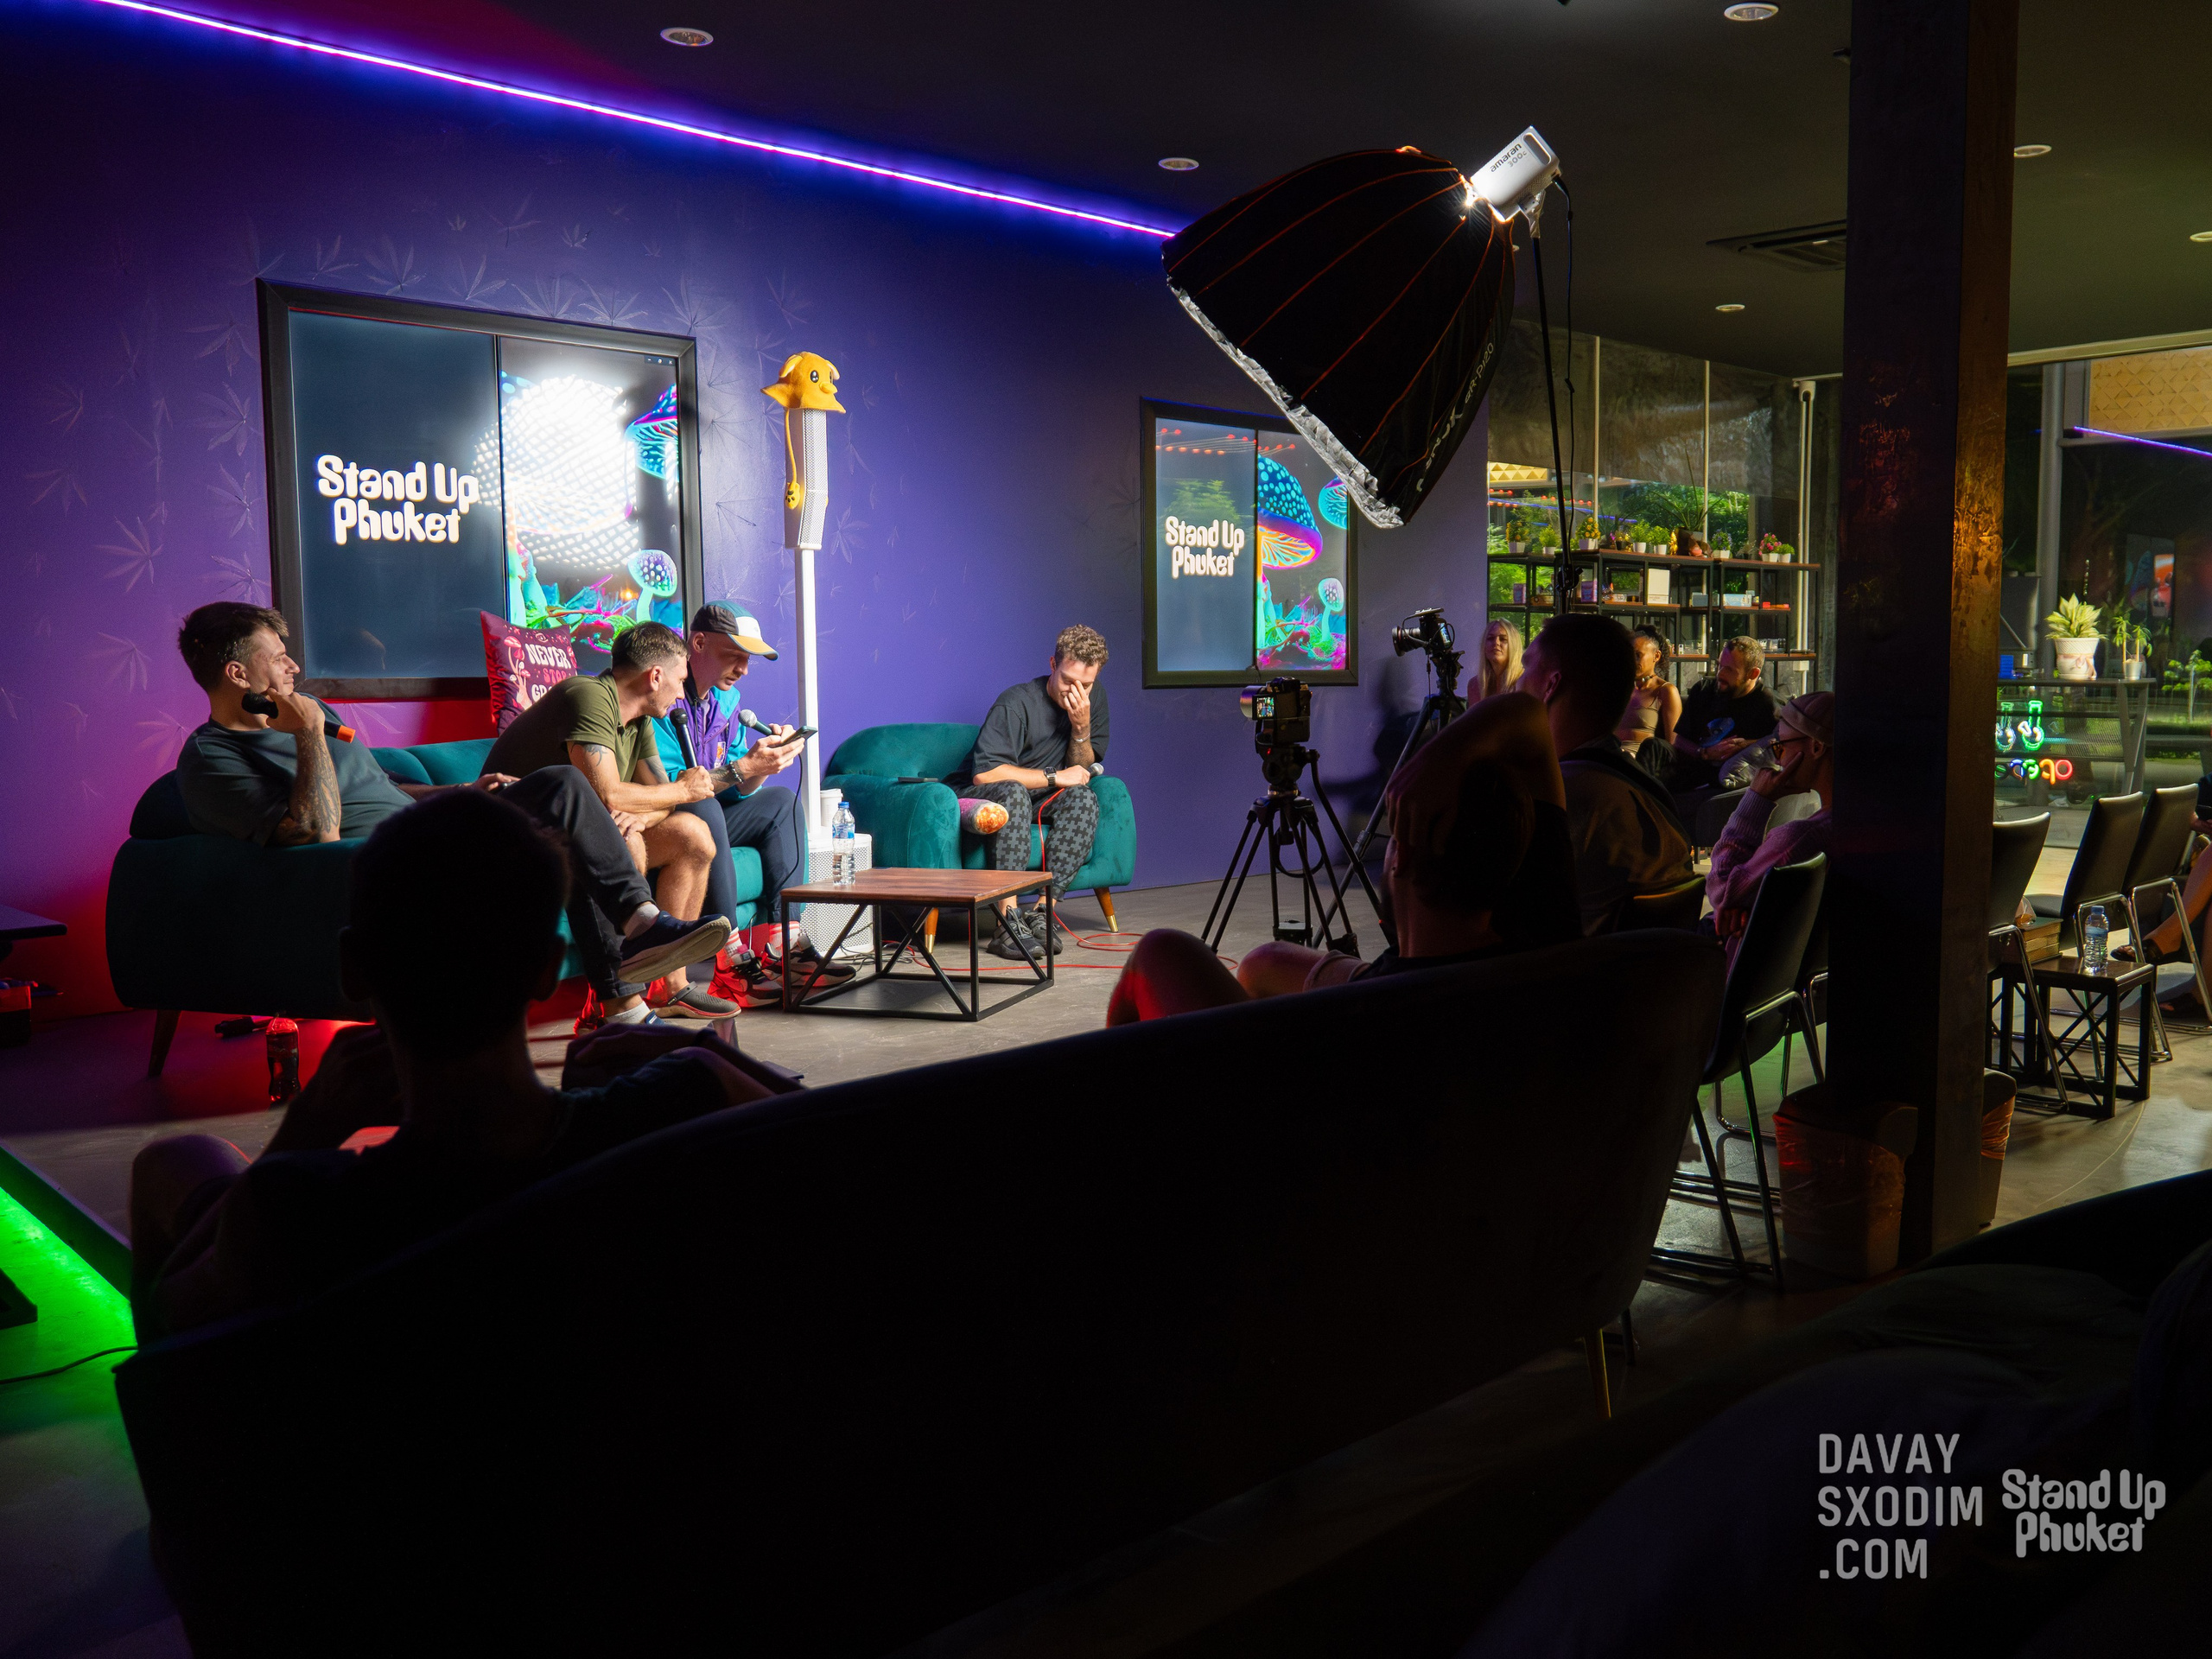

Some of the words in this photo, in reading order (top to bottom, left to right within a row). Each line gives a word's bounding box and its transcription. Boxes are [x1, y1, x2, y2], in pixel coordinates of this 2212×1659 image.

[1490, 143, 1522, 172] amaran
[1508, 151, 1528, 167] 300c
[316, 454, 428, 502] Stand
[434, 462, 480, 514] Up
[334, 498, 461, 545] Phuket
[1166, 516, 1219, 548] Stand
[1222, 520, 1245, 556] Up
[1172, 545, 1235, 579] Phuket
[524, 643, 572, 669] NEVER
[543, 668, 567, 684] STOP
